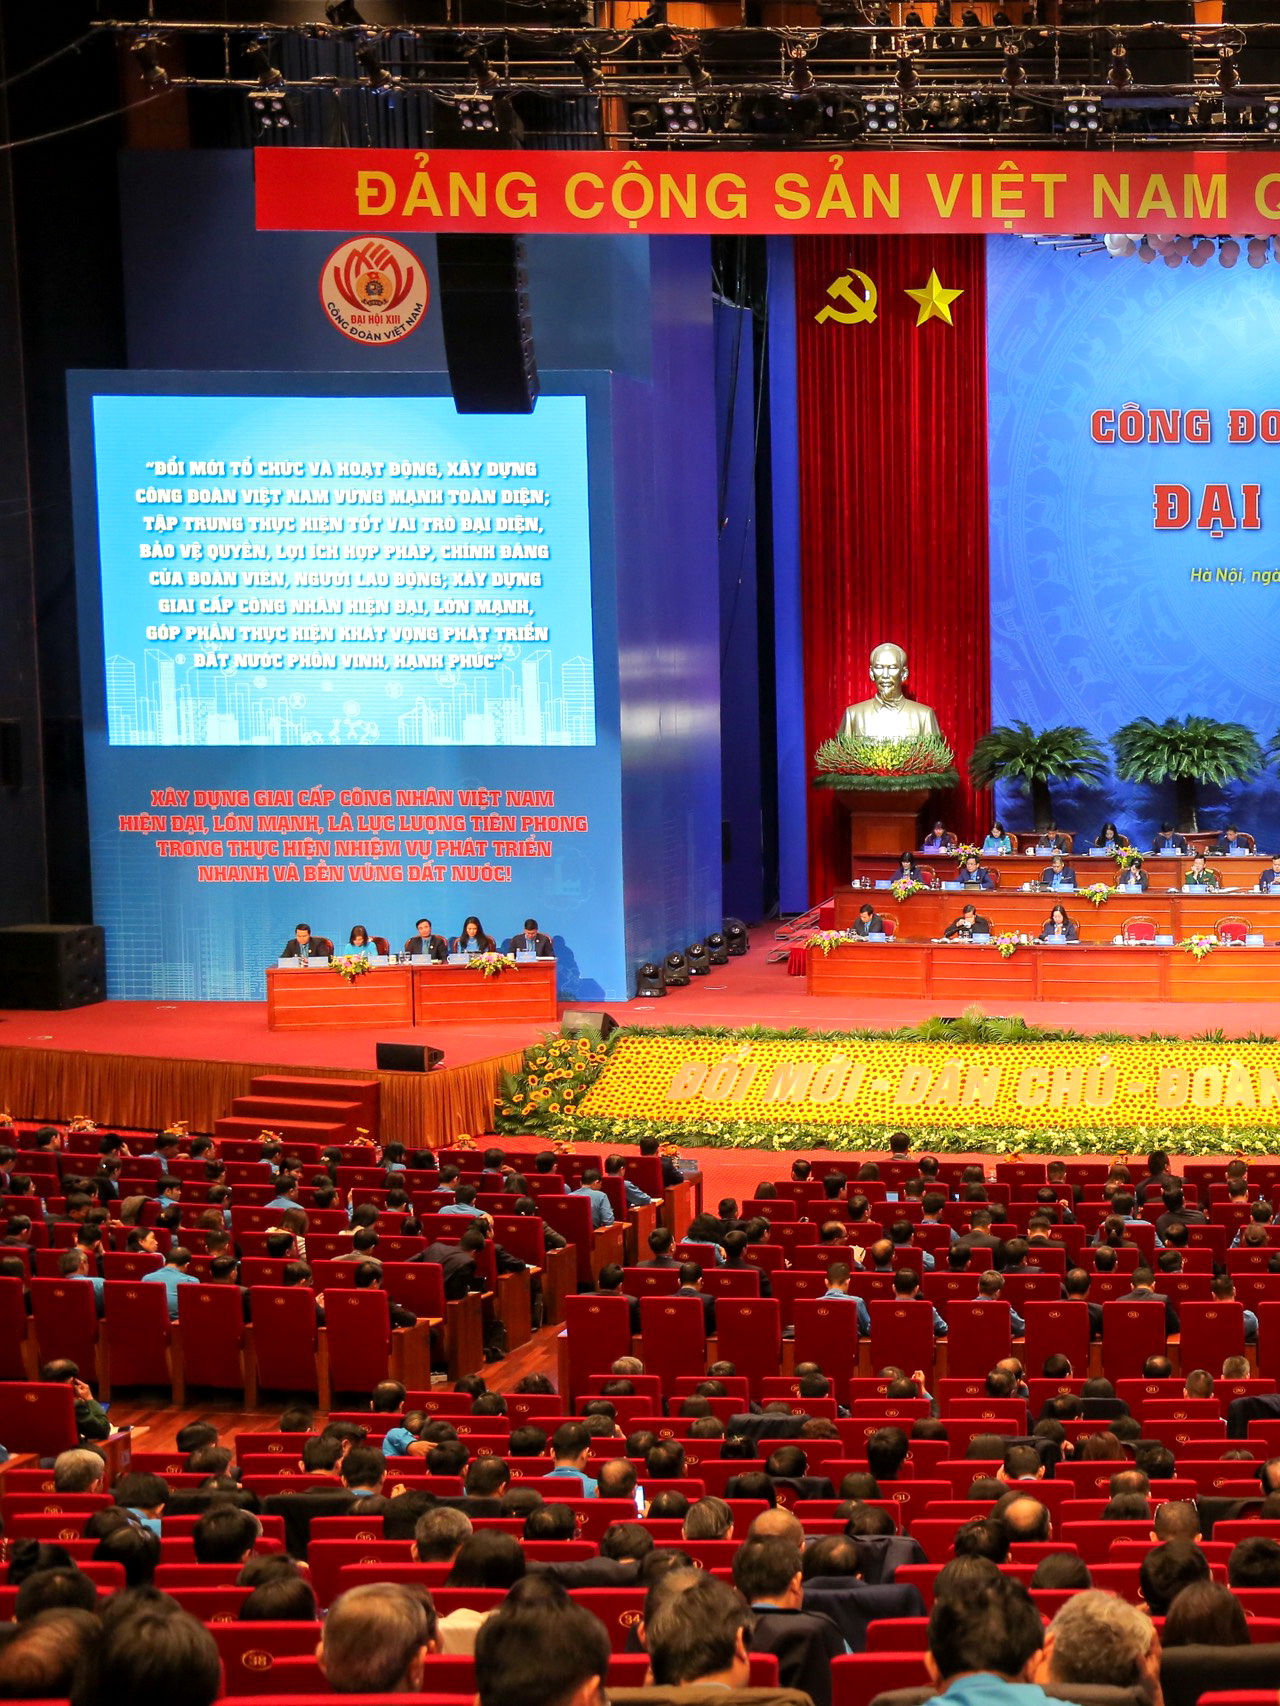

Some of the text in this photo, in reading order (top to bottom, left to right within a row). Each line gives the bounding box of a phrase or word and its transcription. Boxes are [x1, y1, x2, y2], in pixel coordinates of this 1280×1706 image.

[356, 152, 536, 218] ĐẢNG
[565, 161, 746, 228] CỘNG
[775, 155, 899, 219] SẢN
[927, 161, 1066, 228] VIỆT
[1094, 174, 1226, 218] NAM
[327, 302, 349, 330] CÔNG
[350, 326, 381, 340] ĐOÀN
[406, 303, 423, 326] NAM
[351, 313, 400, 326] ĐẠI HỘI XIII
[1091, 402, 1210, 442] CÔNG
[190, 459, 225, 476] MỚI
[230, 456, 252, 476] TỔ
[258, 459, 304, 476] CHỨC
[308, 459, 332, 476] VÀ
[337, 462, 384, 479] HOẠT
[389, 459, 443, 479] ĐỘNG,
[448, 459, 482, 476] XÂY
[488, 462, 537, 479] DỰNG
[1153, 484, 1260, 537] ĐẠI
[1190, 566, 1214, 583] Hà
[1216, 566, 1246, 585] Nội,
[151, 786, 554, 808] XÂY DỰNG GIAI CẤP CÔNG NHÂN VIỆT NAM
[119, 812, 588, 837] HIỆN ĐẠI, LỚN MẠNH, LÀ LỰC LƯỢNG TIÊN PHONG
[156, 837, 552, 862] TRONG THỰC HIỆN NHIỆM VỤ PHÁT TRIỂN
[198, 862, 511, 882] NHANH VÀ BỀN VỮNG ĐẤT NƯỚC!
[667, 1044, 756, 1101] ĐỔI
[763, 1053, 865, 1104] MỚI
[892, 1056, 999, 1105] DÂN
[1014, 1053, 1116, 1108] CHỦ
